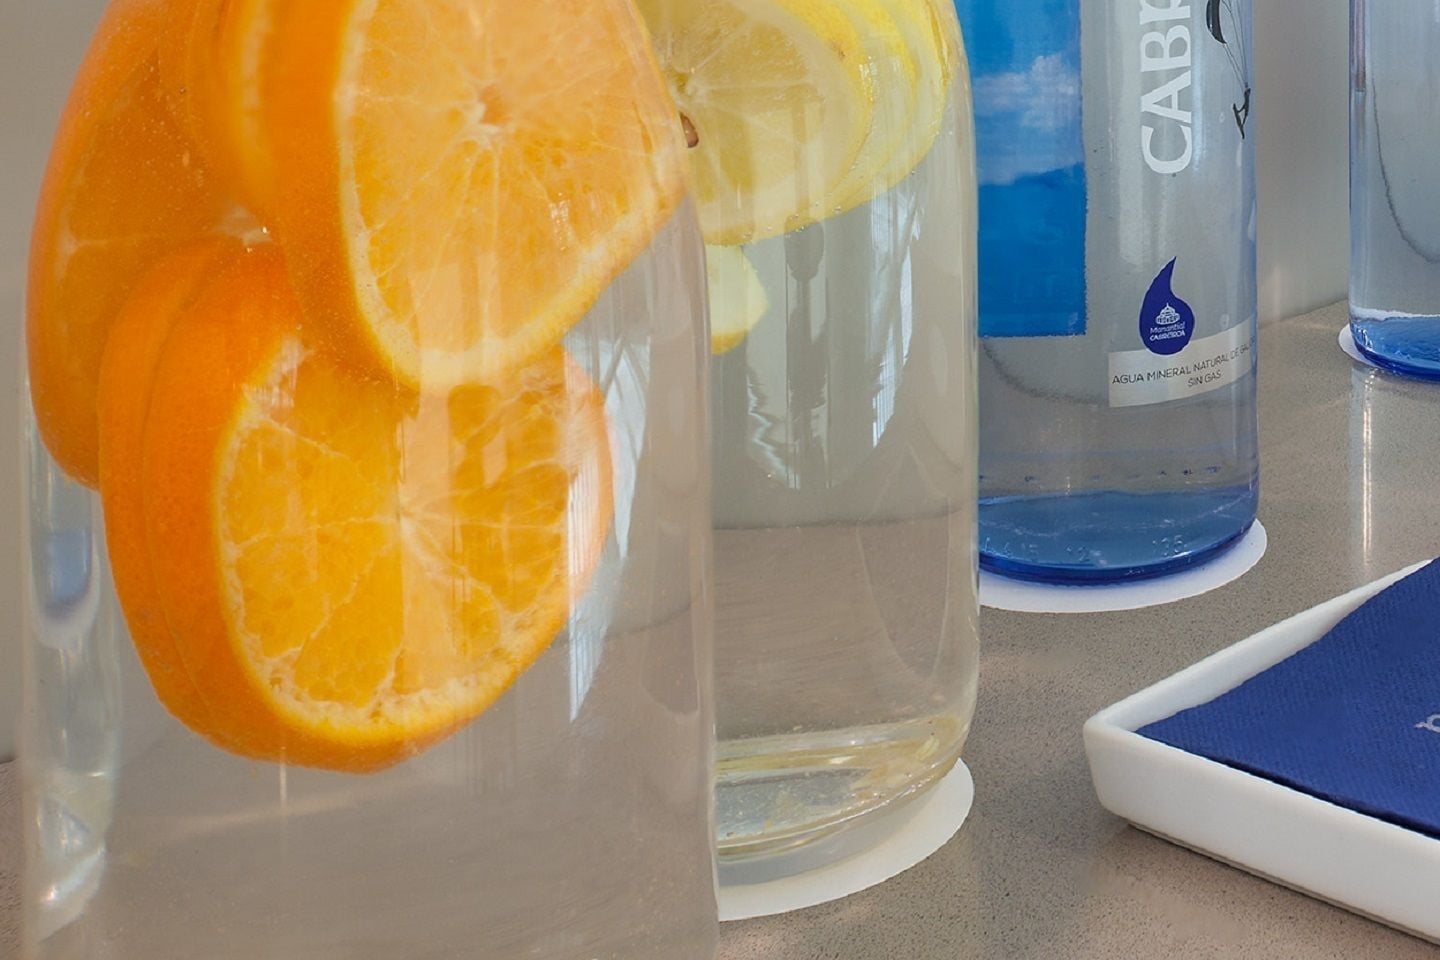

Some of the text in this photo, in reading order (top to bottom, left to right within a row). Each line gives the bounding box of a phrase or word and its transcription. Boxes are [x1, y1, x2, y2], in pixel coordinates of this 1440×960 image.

[1112, 374, 1144, 384] AGUA
[1146, 365, 1191, 381] MINERAL
[1193, 354, 1229, 372] NATURAL
[1187, 369, 1221, 388] SIN GAS
